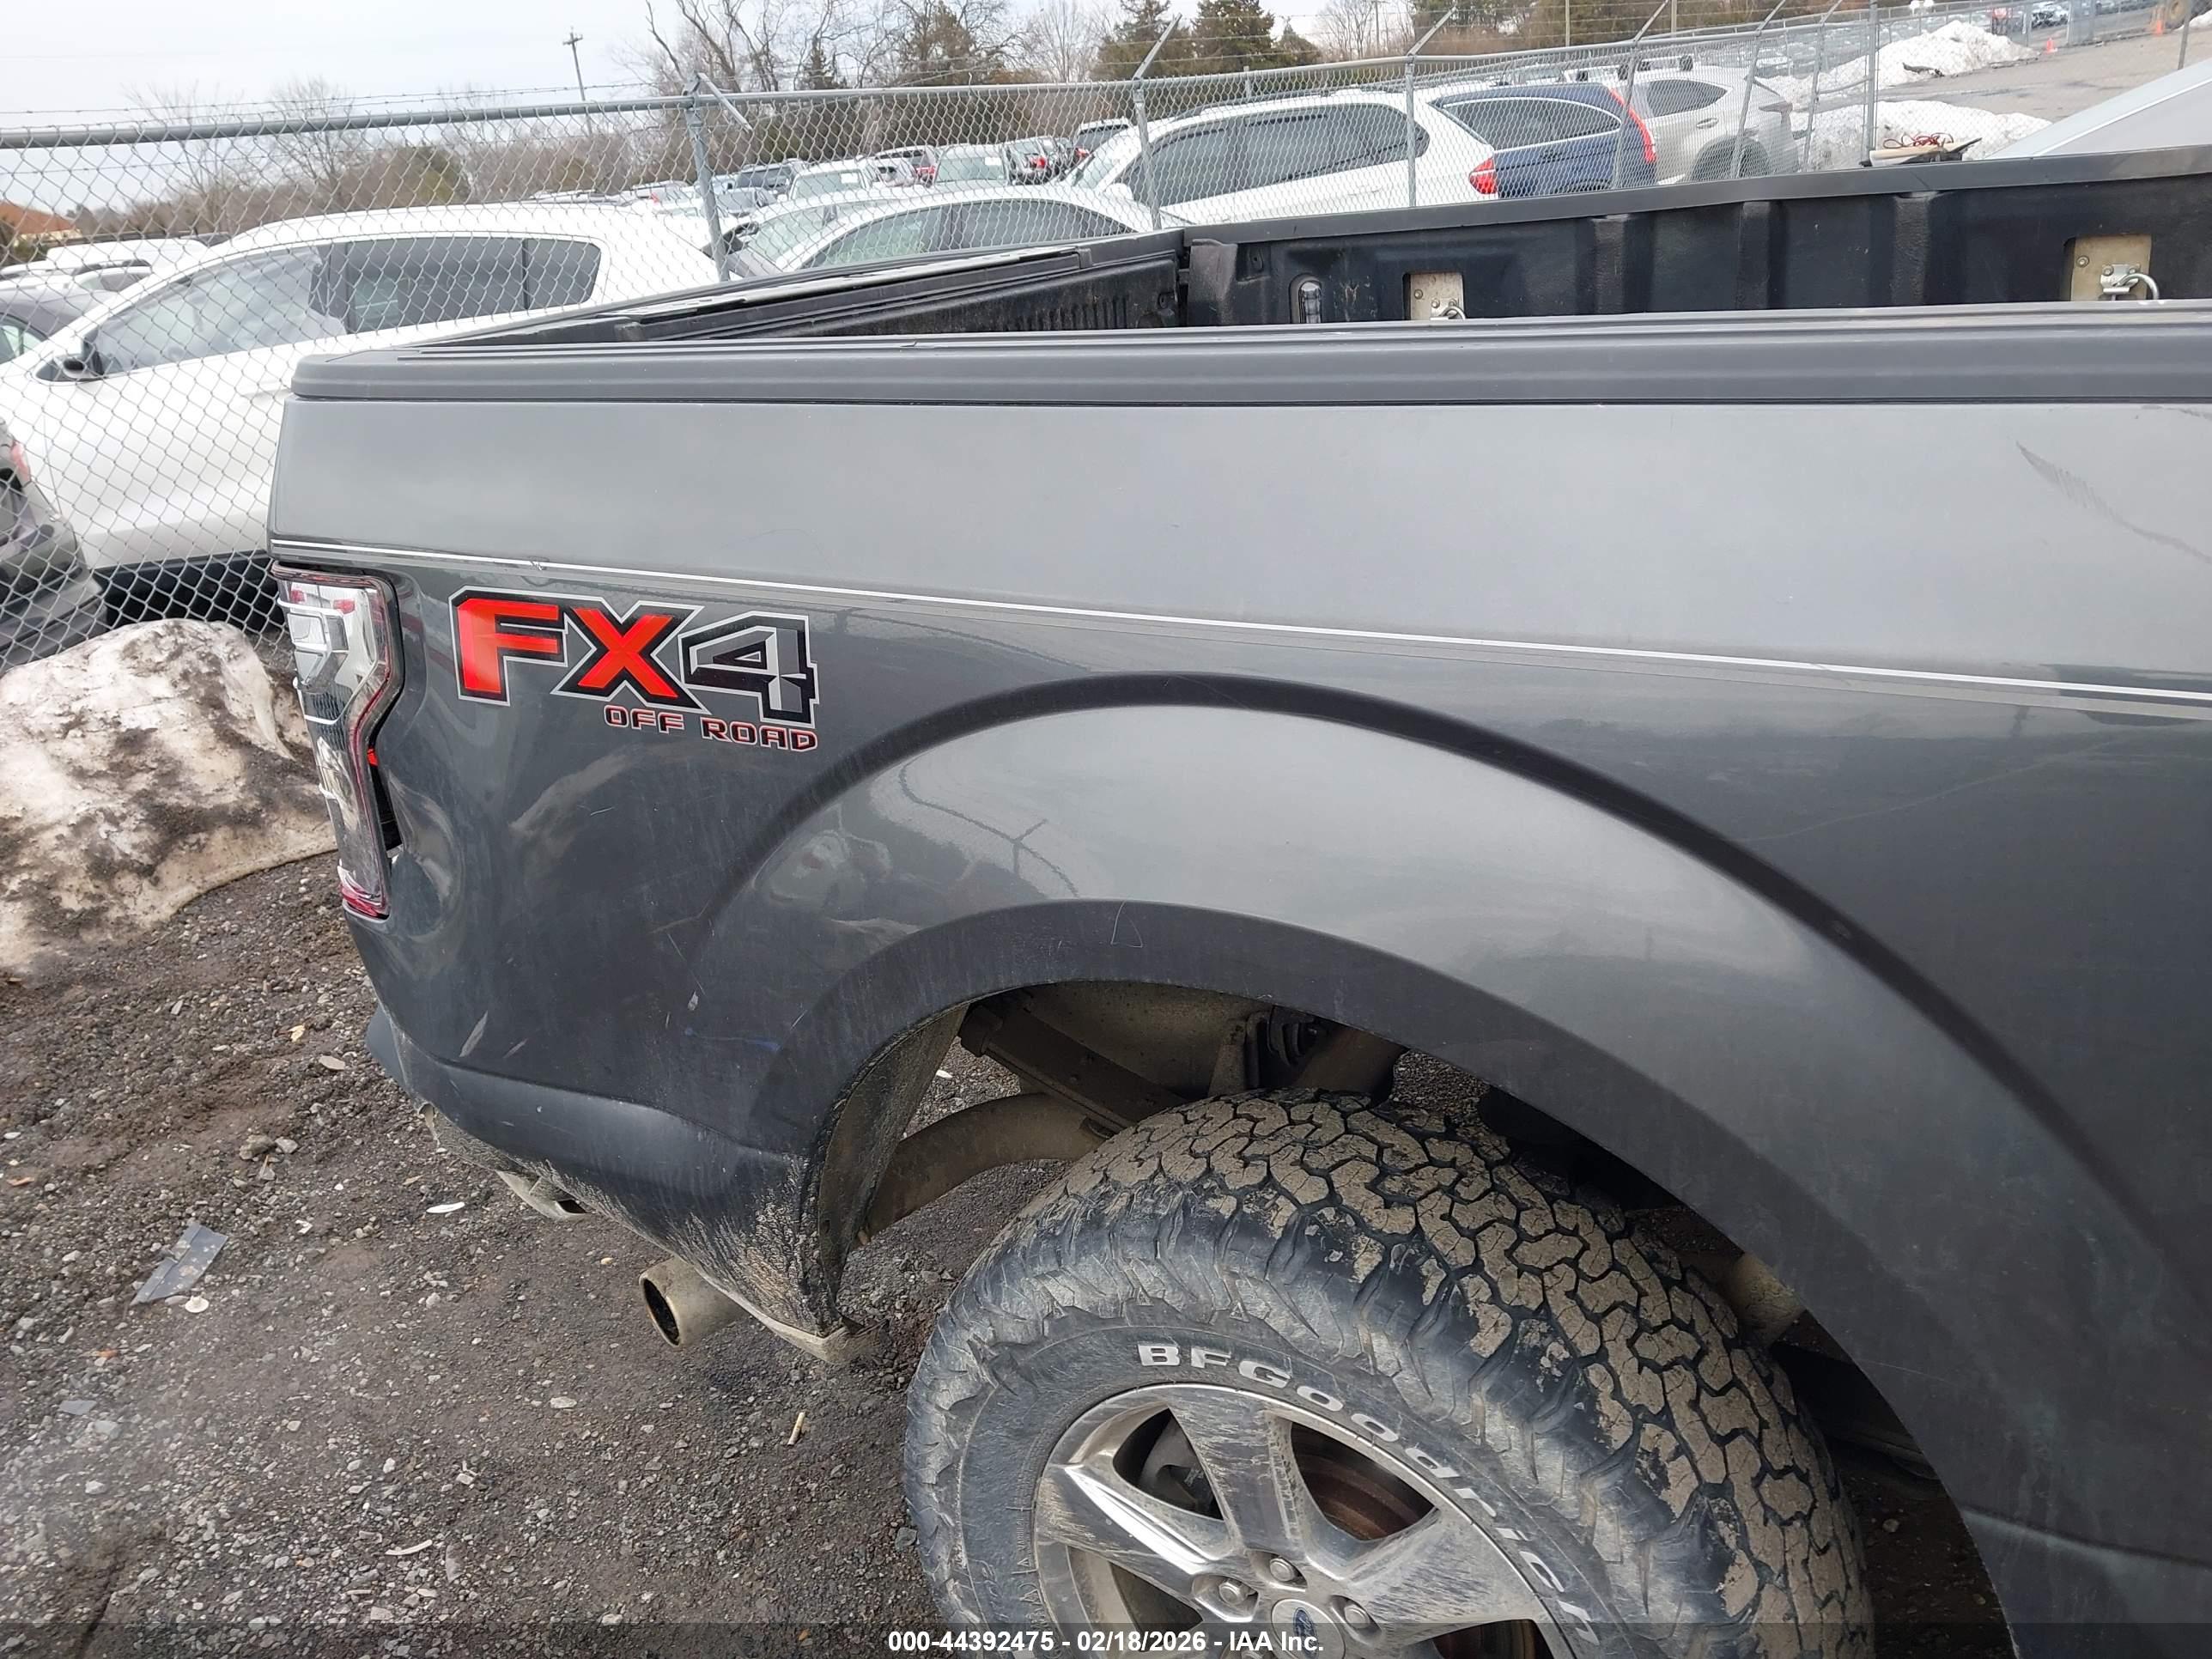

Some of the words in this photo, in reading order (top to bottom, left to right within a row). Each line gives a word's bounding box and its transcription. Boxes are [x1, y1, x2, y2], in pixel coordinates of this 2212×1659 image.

[449, 585, 819, 728] FX4
[604, 704, 684, 734] OFF
[700, 716, 817, 752] ROAD
